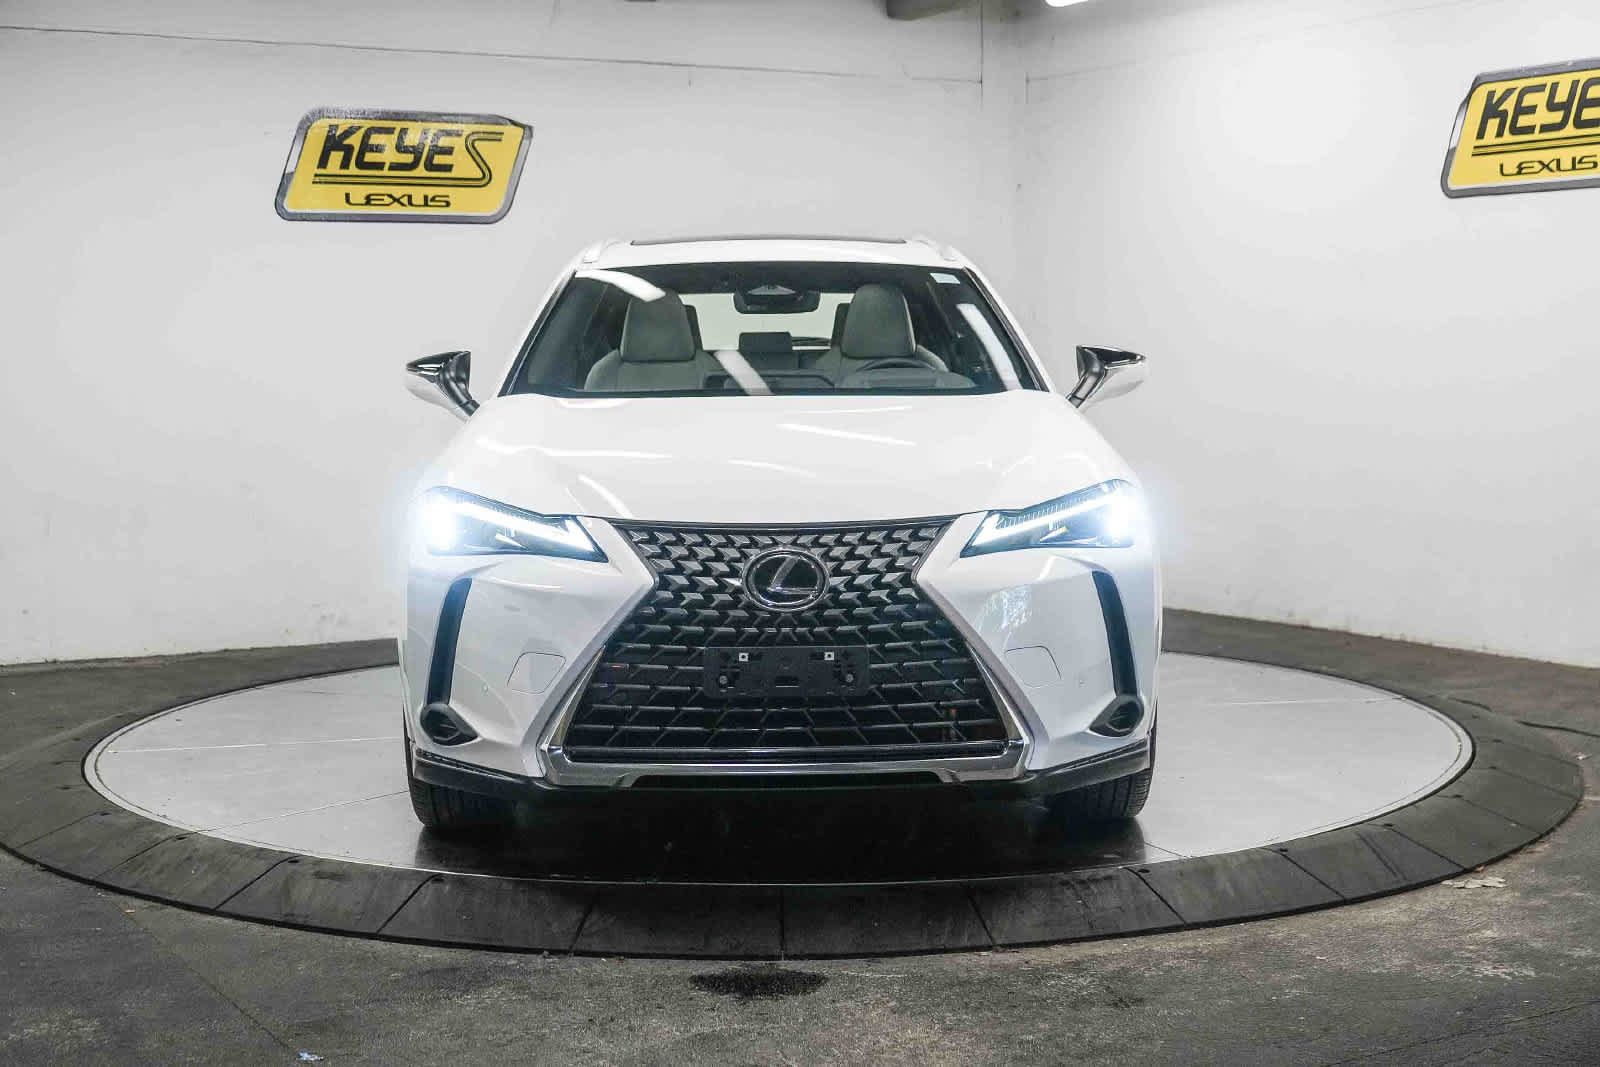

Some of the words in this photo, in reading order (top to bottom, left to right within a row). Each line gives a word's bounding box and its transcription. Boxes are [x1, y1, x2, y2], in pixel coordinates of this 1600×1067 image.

[1475, 76, 1600, 141] KEYE
[316, 124, 504, 187] KEYES
[1500, 154, 1599, 177] LEXUS
[345, 191, 451, 208] LEXUS
